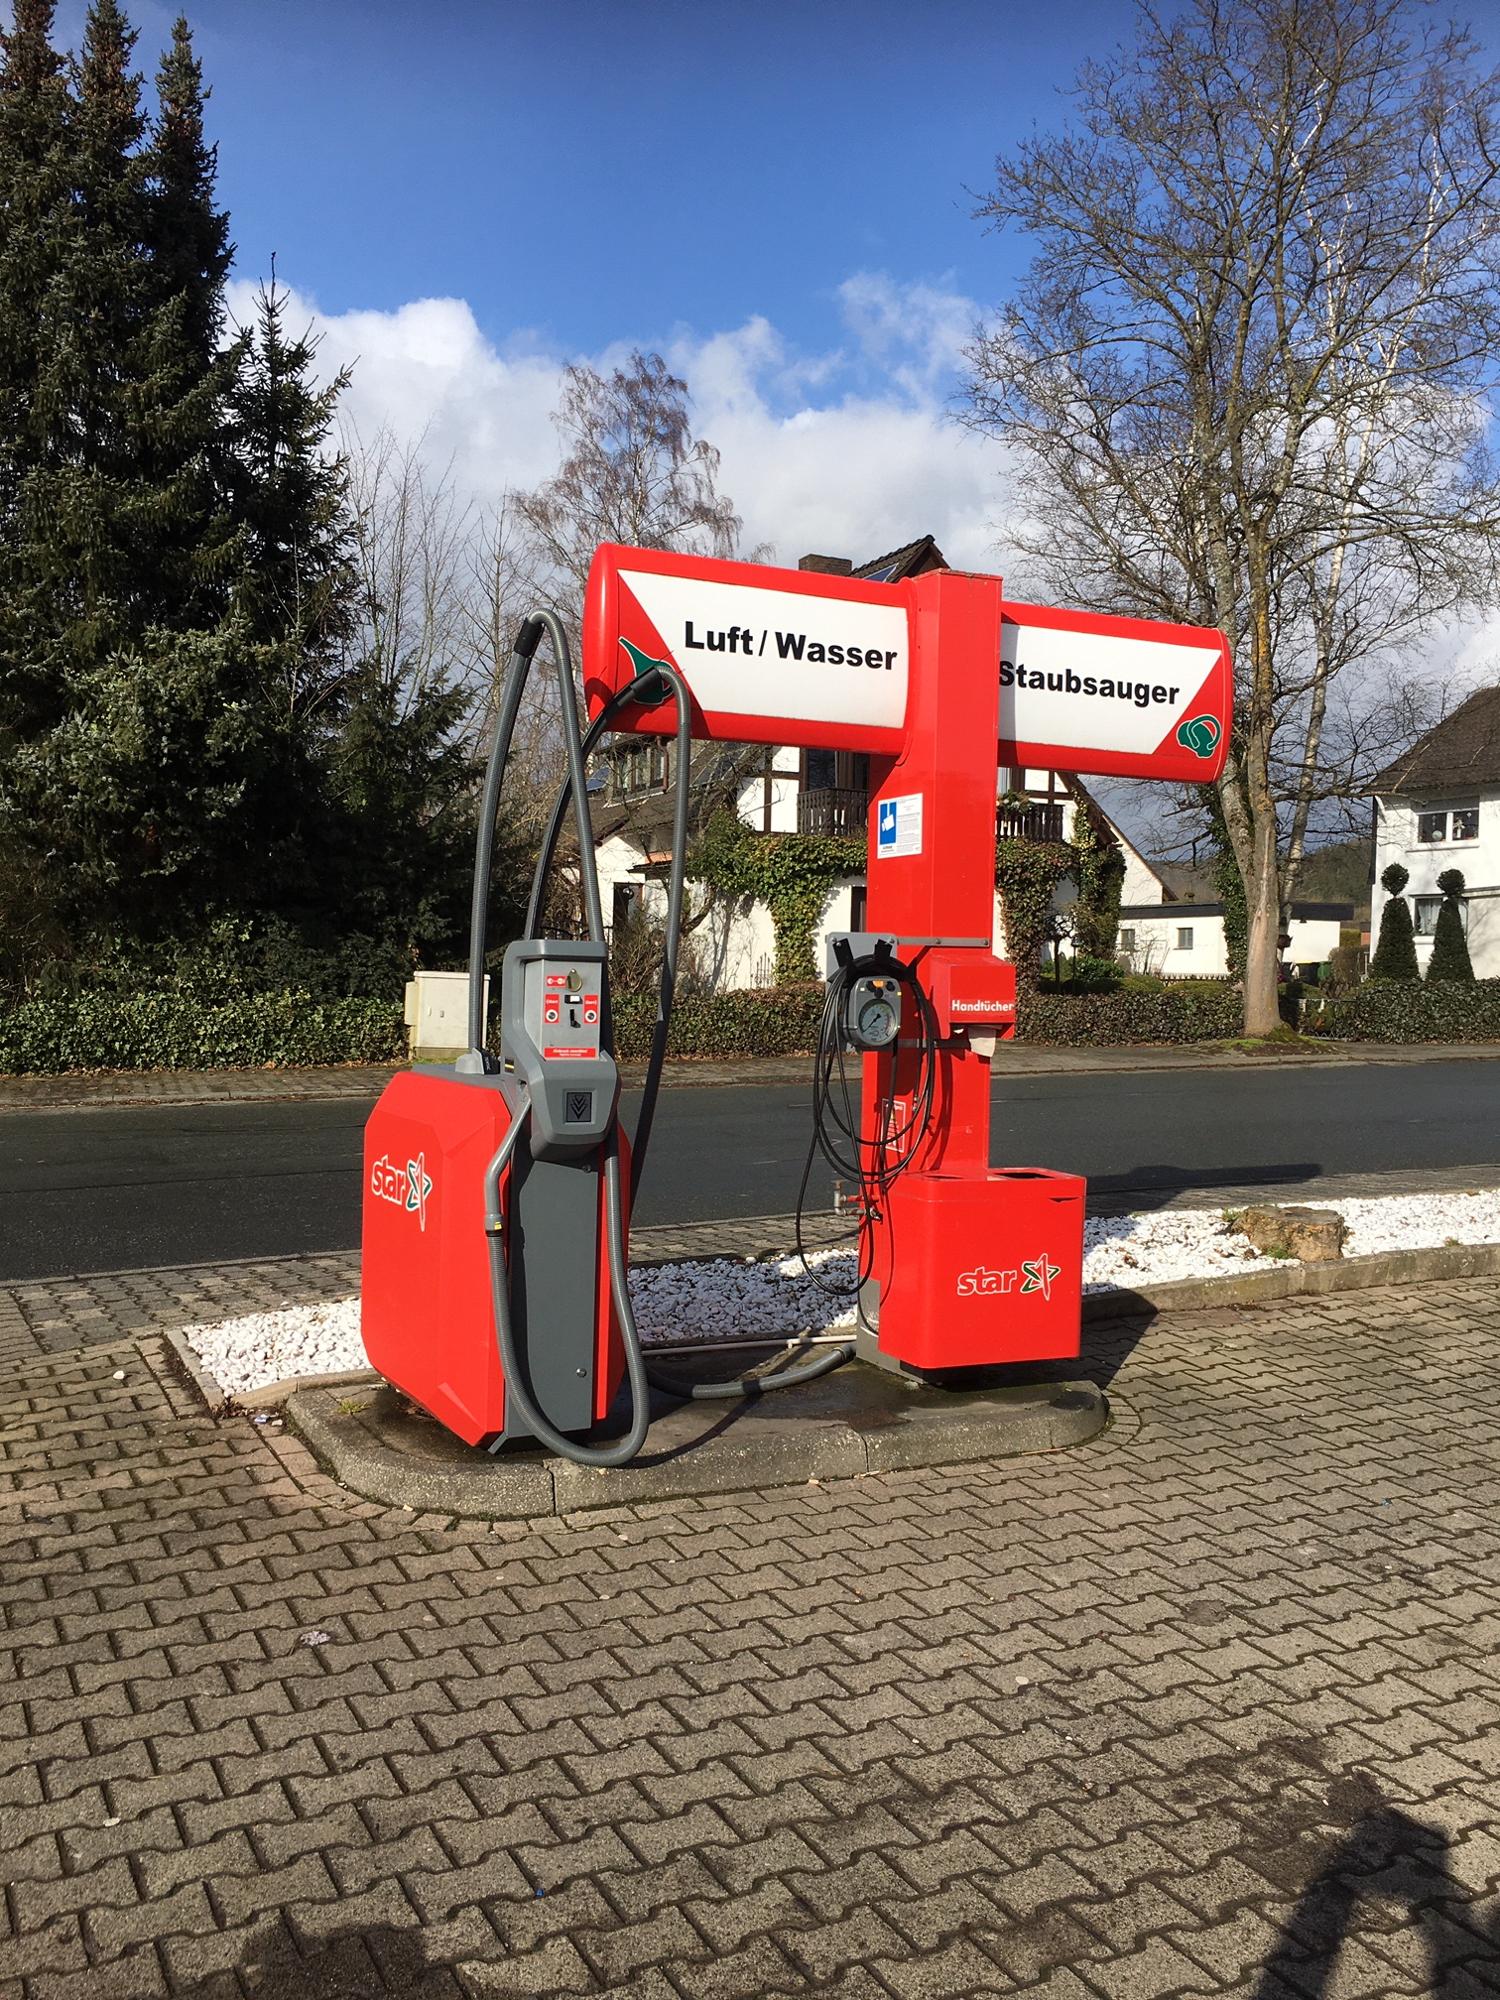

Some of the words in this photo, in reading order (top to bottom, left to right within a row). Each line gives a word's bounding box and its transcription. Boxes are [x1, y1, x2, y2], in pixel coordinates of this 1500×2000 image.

[684, 620, 754, 656] Luft
[775, 631, 898, 670] Wasser
[999, 660, 1180, 707] Staubsauger
[951, 999, 1015, 1012] Handtücher
[371, 1154, 407, 1206] star
[956, 1266, 1018, 1296] star
